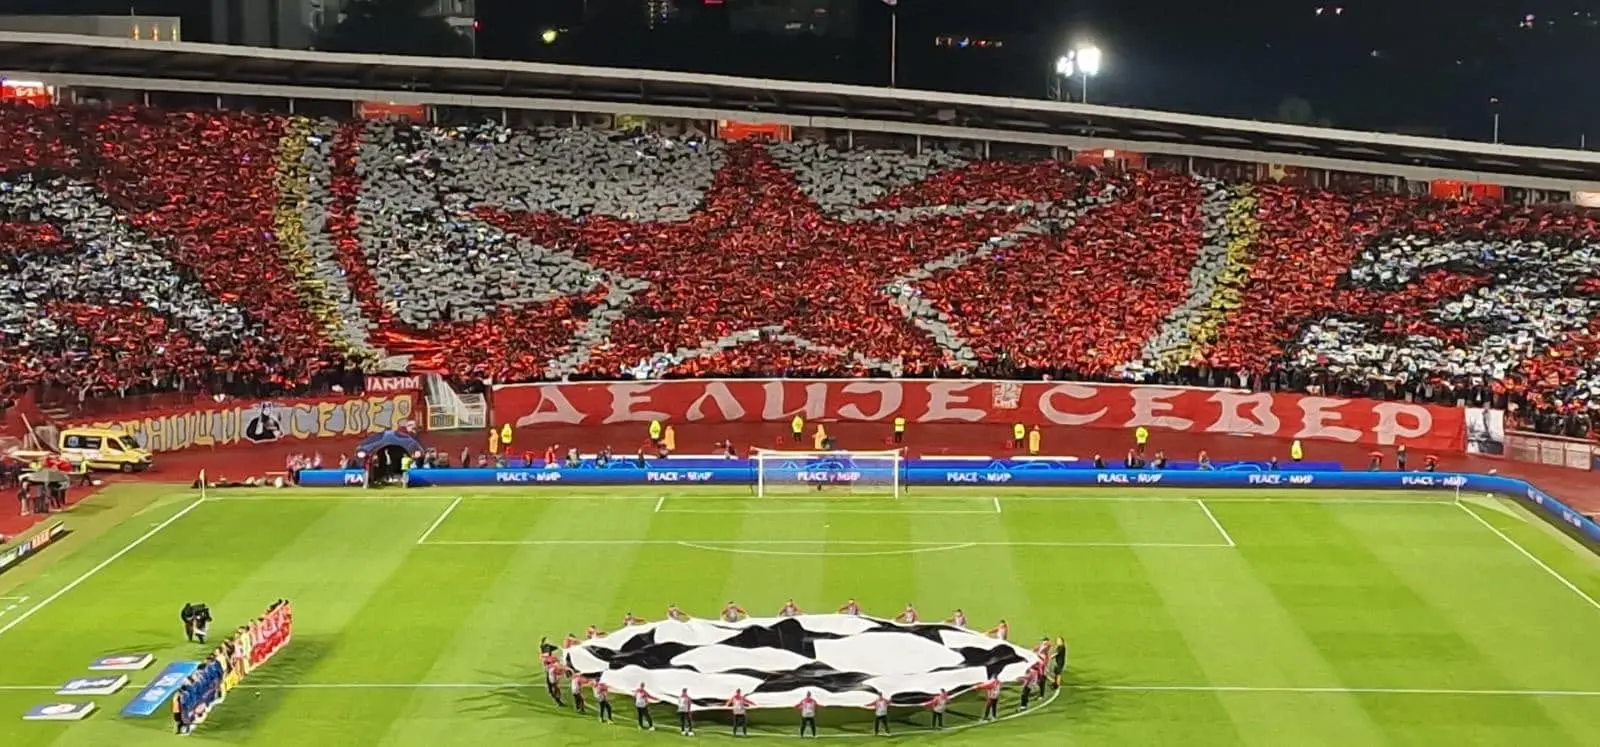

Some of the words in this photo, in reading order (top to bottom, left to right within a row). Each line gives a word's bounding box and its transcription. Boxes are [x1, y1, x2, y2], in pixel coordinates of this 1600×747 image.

[291, 394, 412, 439] СЕВЕР
[516, 381, 987, 427] ДЕЛИЈЕ
[1039, 384, 1433, 445] СЕВЕР
